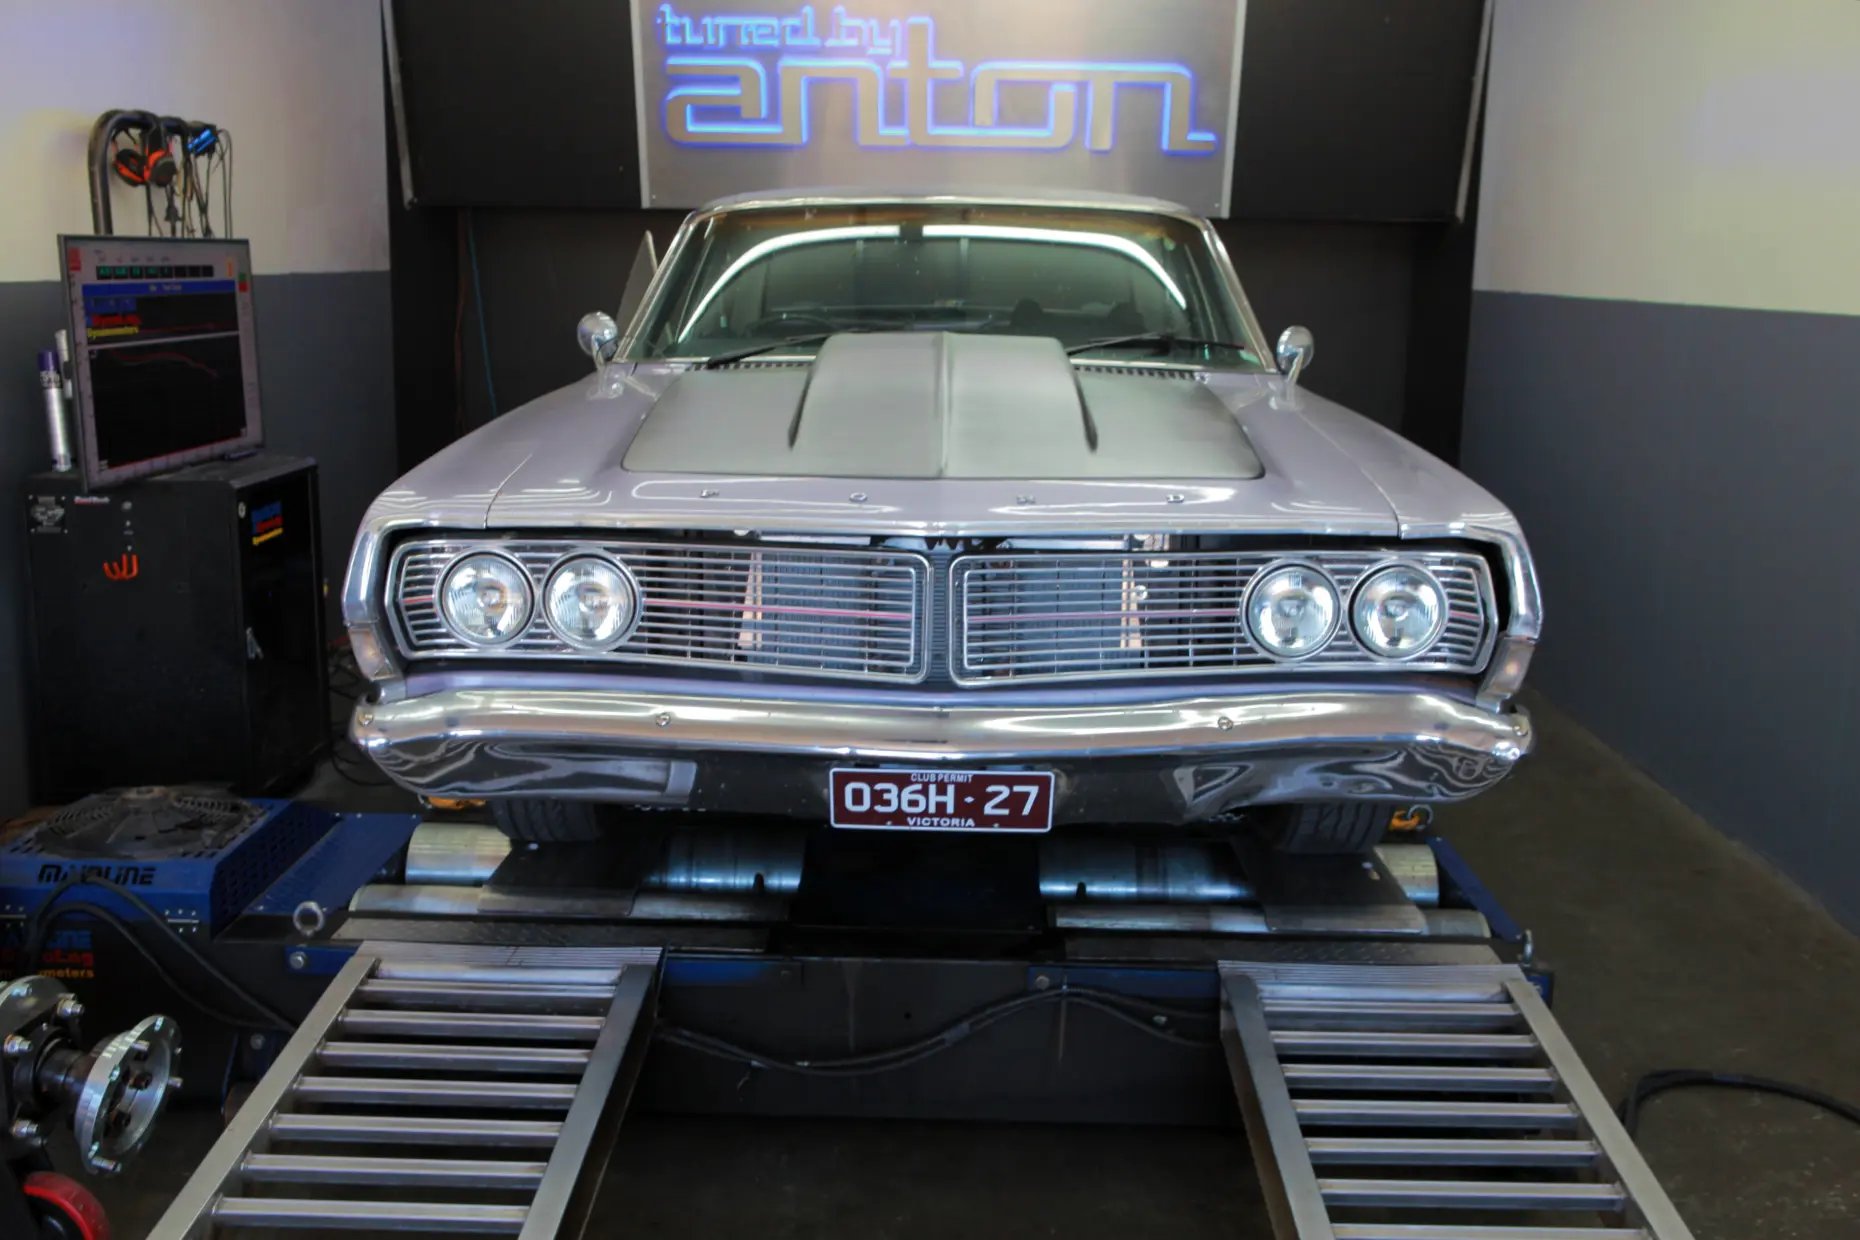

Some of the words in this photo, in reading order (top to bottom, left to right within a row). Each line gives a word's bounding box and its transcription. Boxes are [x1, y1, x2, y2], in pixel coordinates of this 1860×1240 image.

[657, 4, 820, 48] tuned
[825, 6, 900, 55] by
[665, 16, 1217, 153] anton
[910, 773, 936, 782] CLUB
[938, 773, 973, 783] PERMIT
[907, 817, 975, 828] VICTORIA
